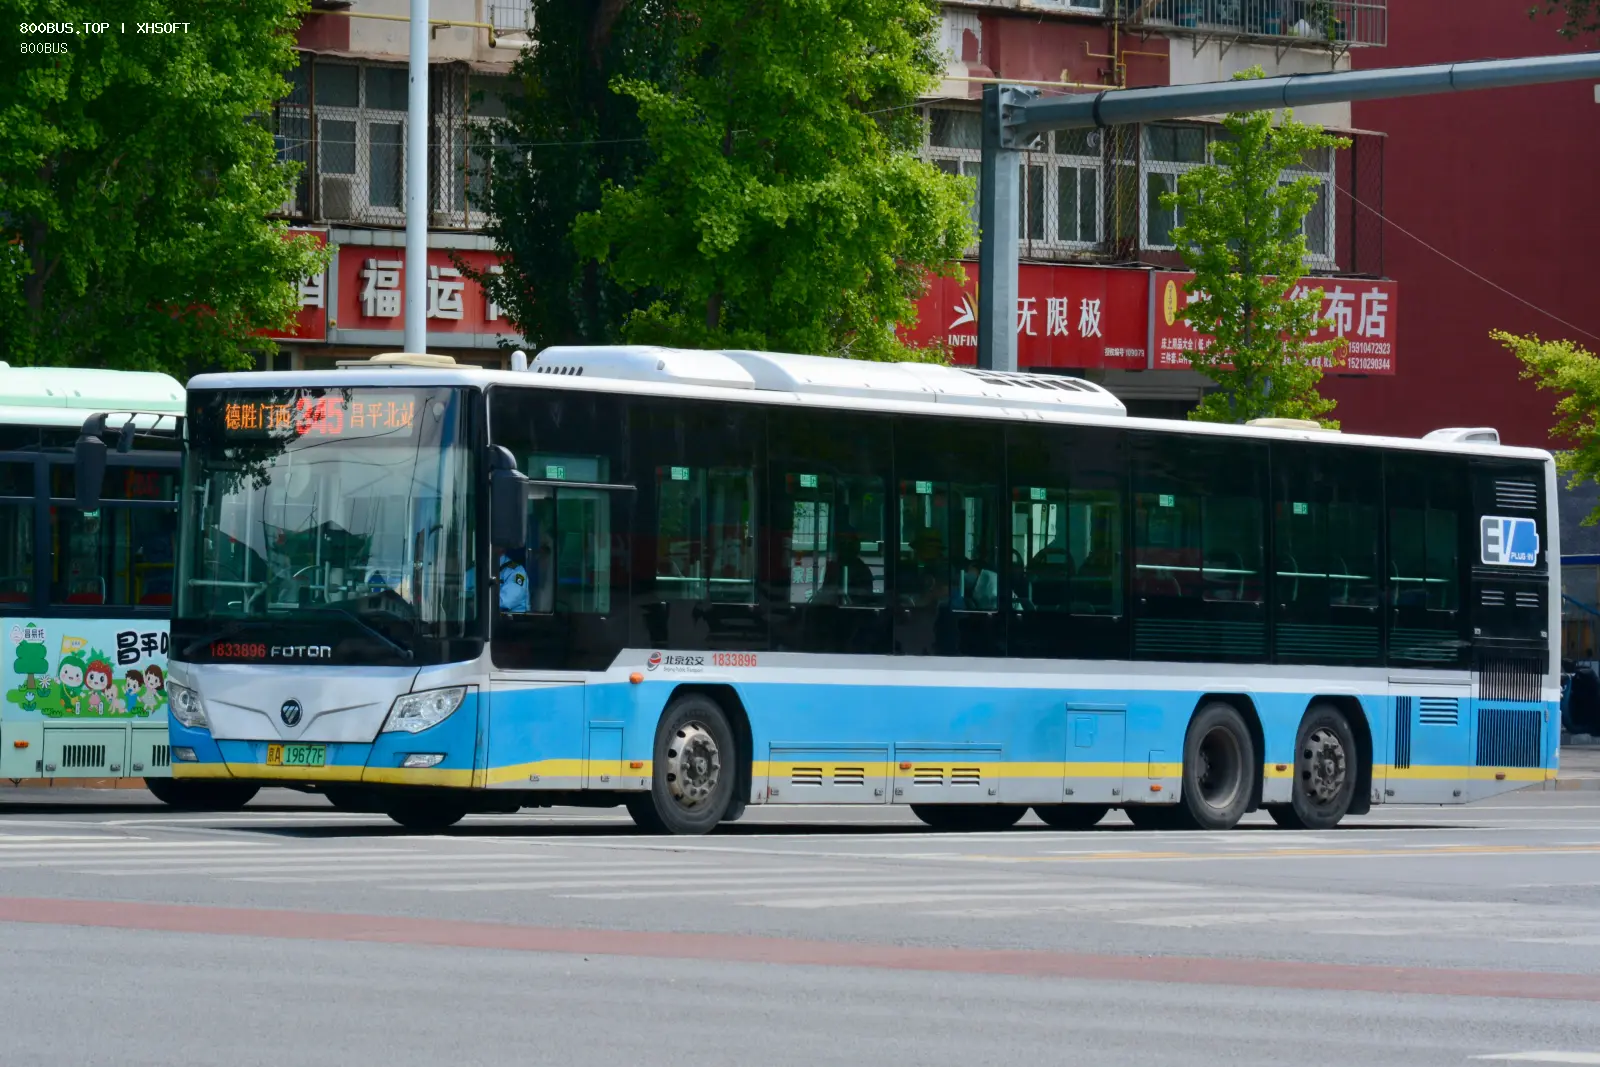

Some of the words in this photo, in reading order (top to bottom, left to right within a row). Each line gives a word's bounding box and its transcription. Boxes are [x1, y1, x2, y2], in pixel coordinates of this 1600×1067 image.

[361, 258, 507, 321] 福运
[1017, 296, 1102, 338] 无限极
[948, 334, 978, 346] INFIN
[1348, 342, 1391, 354] 15910472923
[1347, 357, 1391, 369] 15210290344
[225, 402, 292, 430] 德胜门西
[296, 397, 344, 434] 345
[350, 402, 414, 428] 昌平北站
[1510, 551, 1534, 561] PLUG-IN
[210, 643, 267, 657] 1833896
[271, 645, 331, 658] FOTON
[664, 655, 704, 665] 北京公交
[712, 652, 757, 667] 1833896
